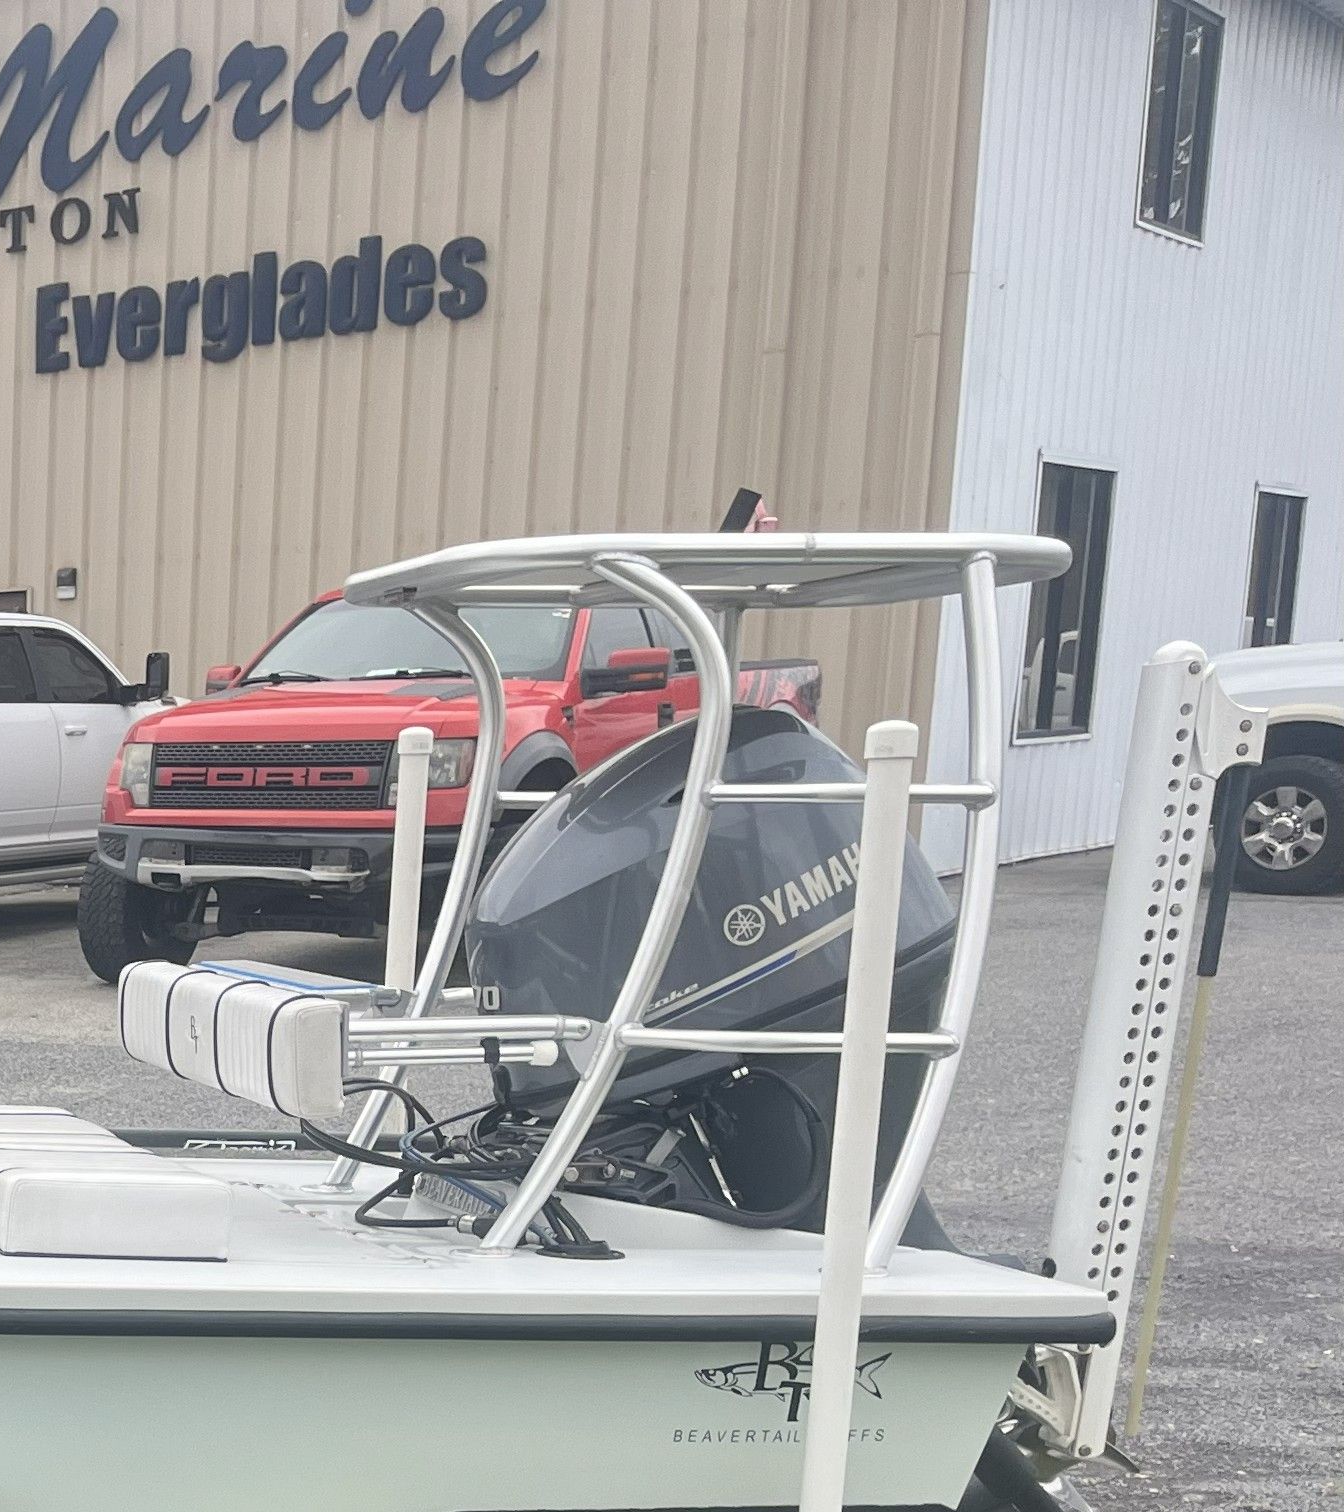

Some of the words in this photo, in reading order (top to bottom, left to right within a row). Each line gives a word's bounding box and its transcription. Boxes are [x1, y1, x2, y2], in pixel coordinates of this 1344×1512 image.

[35, 235, 489, 374] Everglades
[158, 766, 370, 787] FORD
[759, 842, 862, 926] YAMAH
[672, 1428, 801, 1443] BEAVERTAIL
